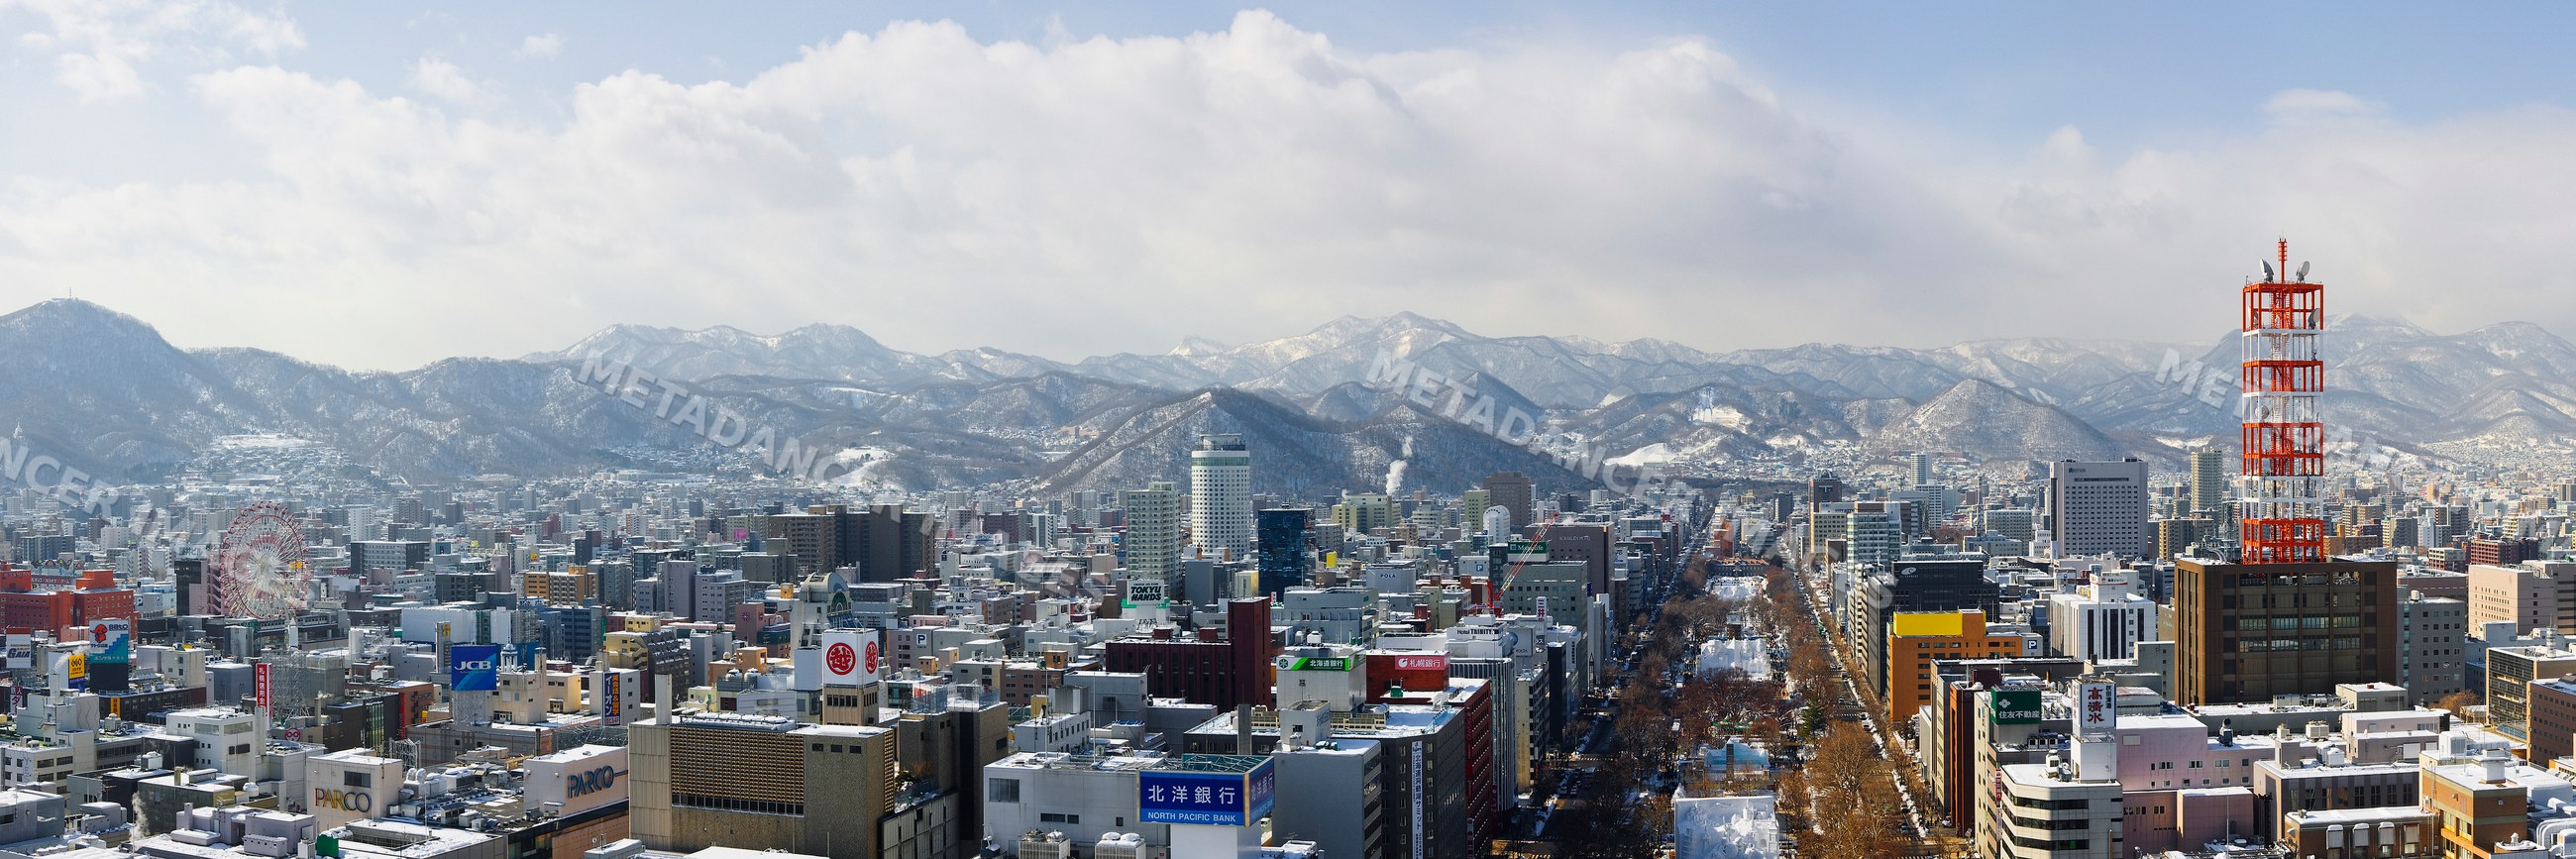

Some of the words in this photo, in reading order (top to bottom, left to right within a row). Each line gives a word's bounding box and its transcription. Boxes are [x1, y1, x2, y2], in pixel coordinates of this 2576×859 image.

[1130, 586, 1162, 594] TOKYU
[7, 648, 30, 658] GAIA
[454, 660, 492, 671] JCB
[1309, 659, 1344, 668] 北海道銀行
[1409, 658, 1442, 668] 札幌銀行
[1998, 710, 2040, 719] 住友不動産
[568, 765, 615, 800] PARCO
[314, 787, 373, 812] PARCO
[1147, 785, 1235, 805] 北洋銀行
[1147, 811, 1176, 820] NORTH
